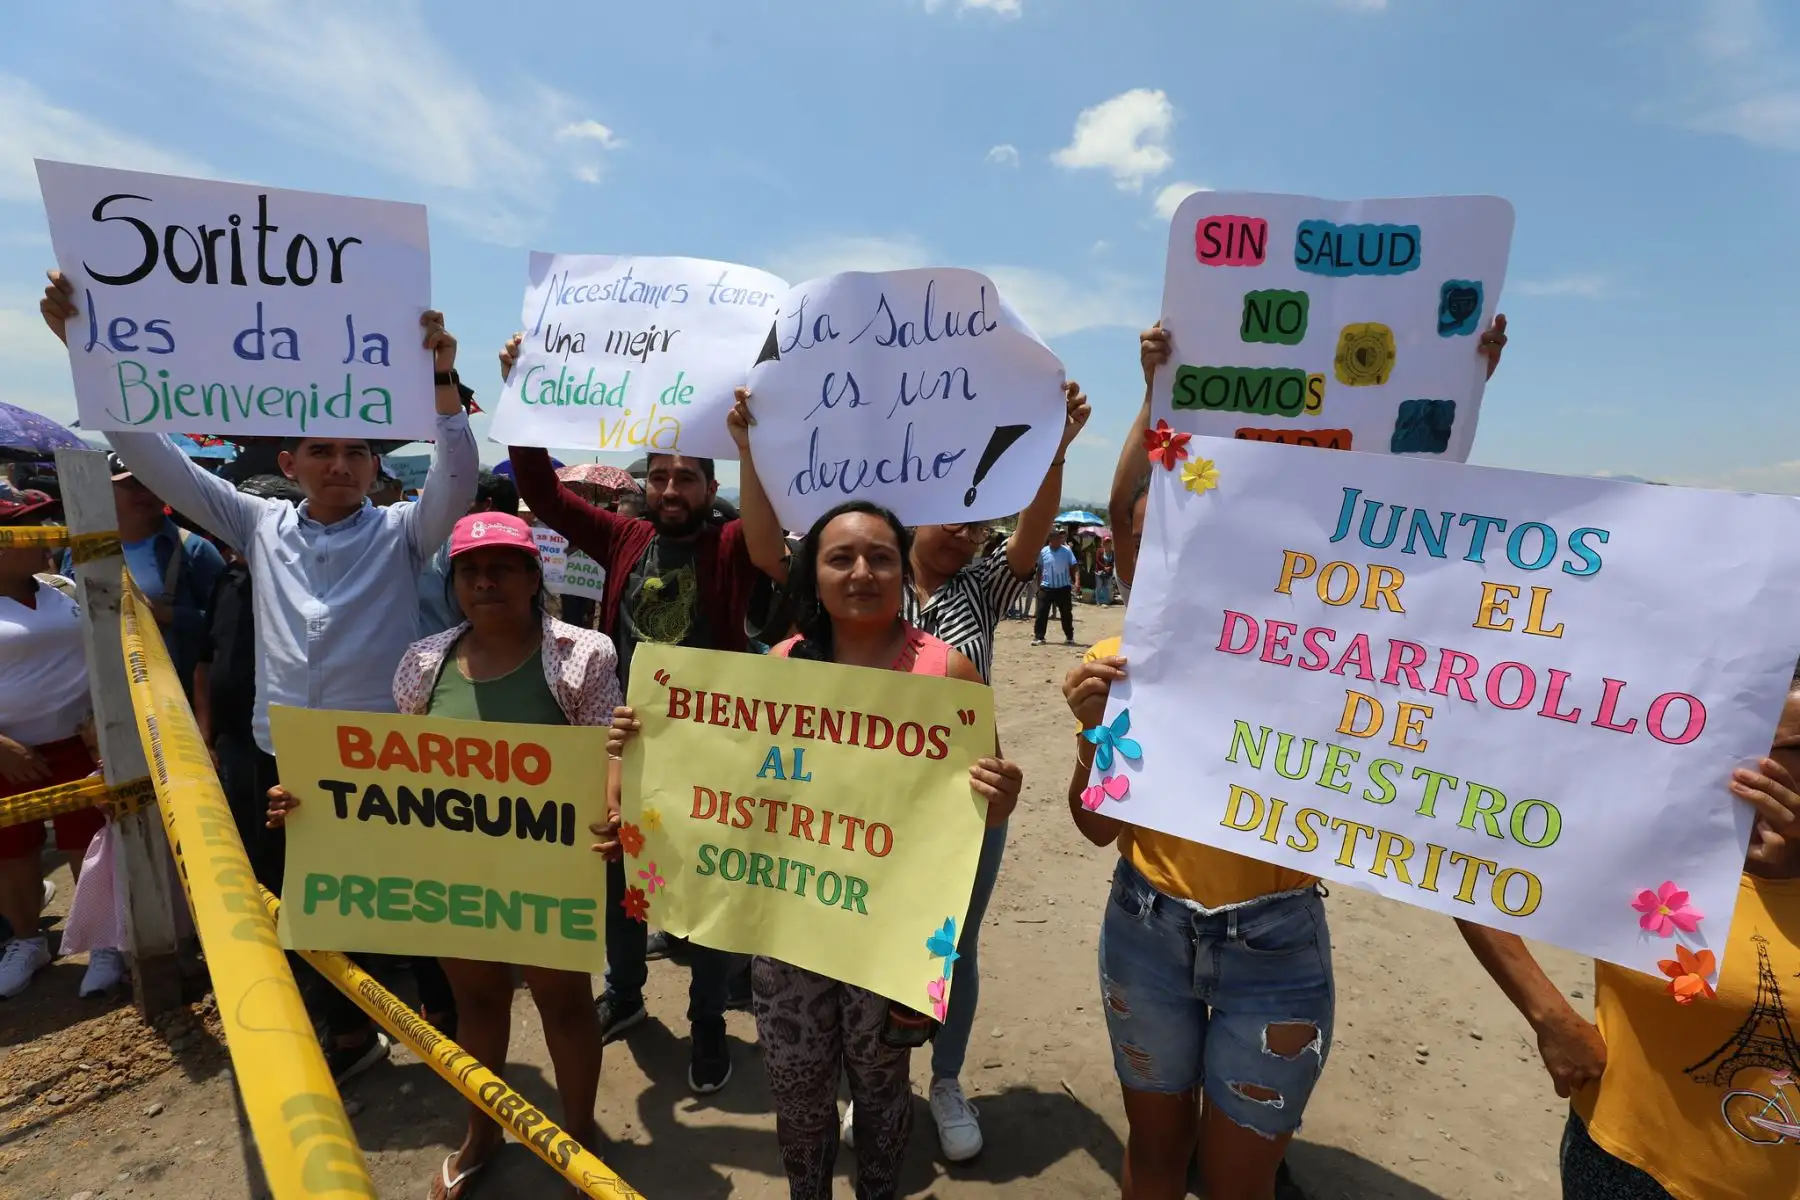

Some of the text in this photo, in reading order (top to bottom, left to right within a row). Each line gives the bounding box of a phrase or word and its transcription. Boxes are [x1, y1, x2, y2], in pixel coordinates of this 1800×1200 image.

[83, 194, 362, 286] Soritor
[1200, 221, 1416, 268] SIN SALUD
[85, 288, 175, 354] Les
[233, 302, 301, 361] da
[534, 266, 775, 336] Necesitamos tener
[1244, 299, 1303, 334] NO
[605, 324, 681, 363] mejor
[106, 360, 393, 432] Bienvenida
[520, 365, 695, 408] Calidad de
[804, 367, 977, 421] es un
[1174, 373, 1322, 411] SOMOS
[598, 403, 682, 450] vida
[1329, 486, 1611, 578] JUNTOS
[567, 562, 599, 577] PARA
[1273, 549, 1566, 639] POR EL
[1215, 609, 1708, 745] DESARROLLO
[1335, 689, 1434, 752] DE
[336, 725, 552, 786] BARRIO
[756, 745, 812, 782] AL
[1225, 720, 1563, 849] NUESTRO
[318, 779, 576, 847] TANGUMI
[690, 785, 894, 858] DISTRITO
[696, 843, 870, 916] SORITOR
[1220, 783, 1543, 917] DISTRITO
[303, 872, 598, 941] PRESENTE
[479, 1080, 581, 1173] OBRAS
